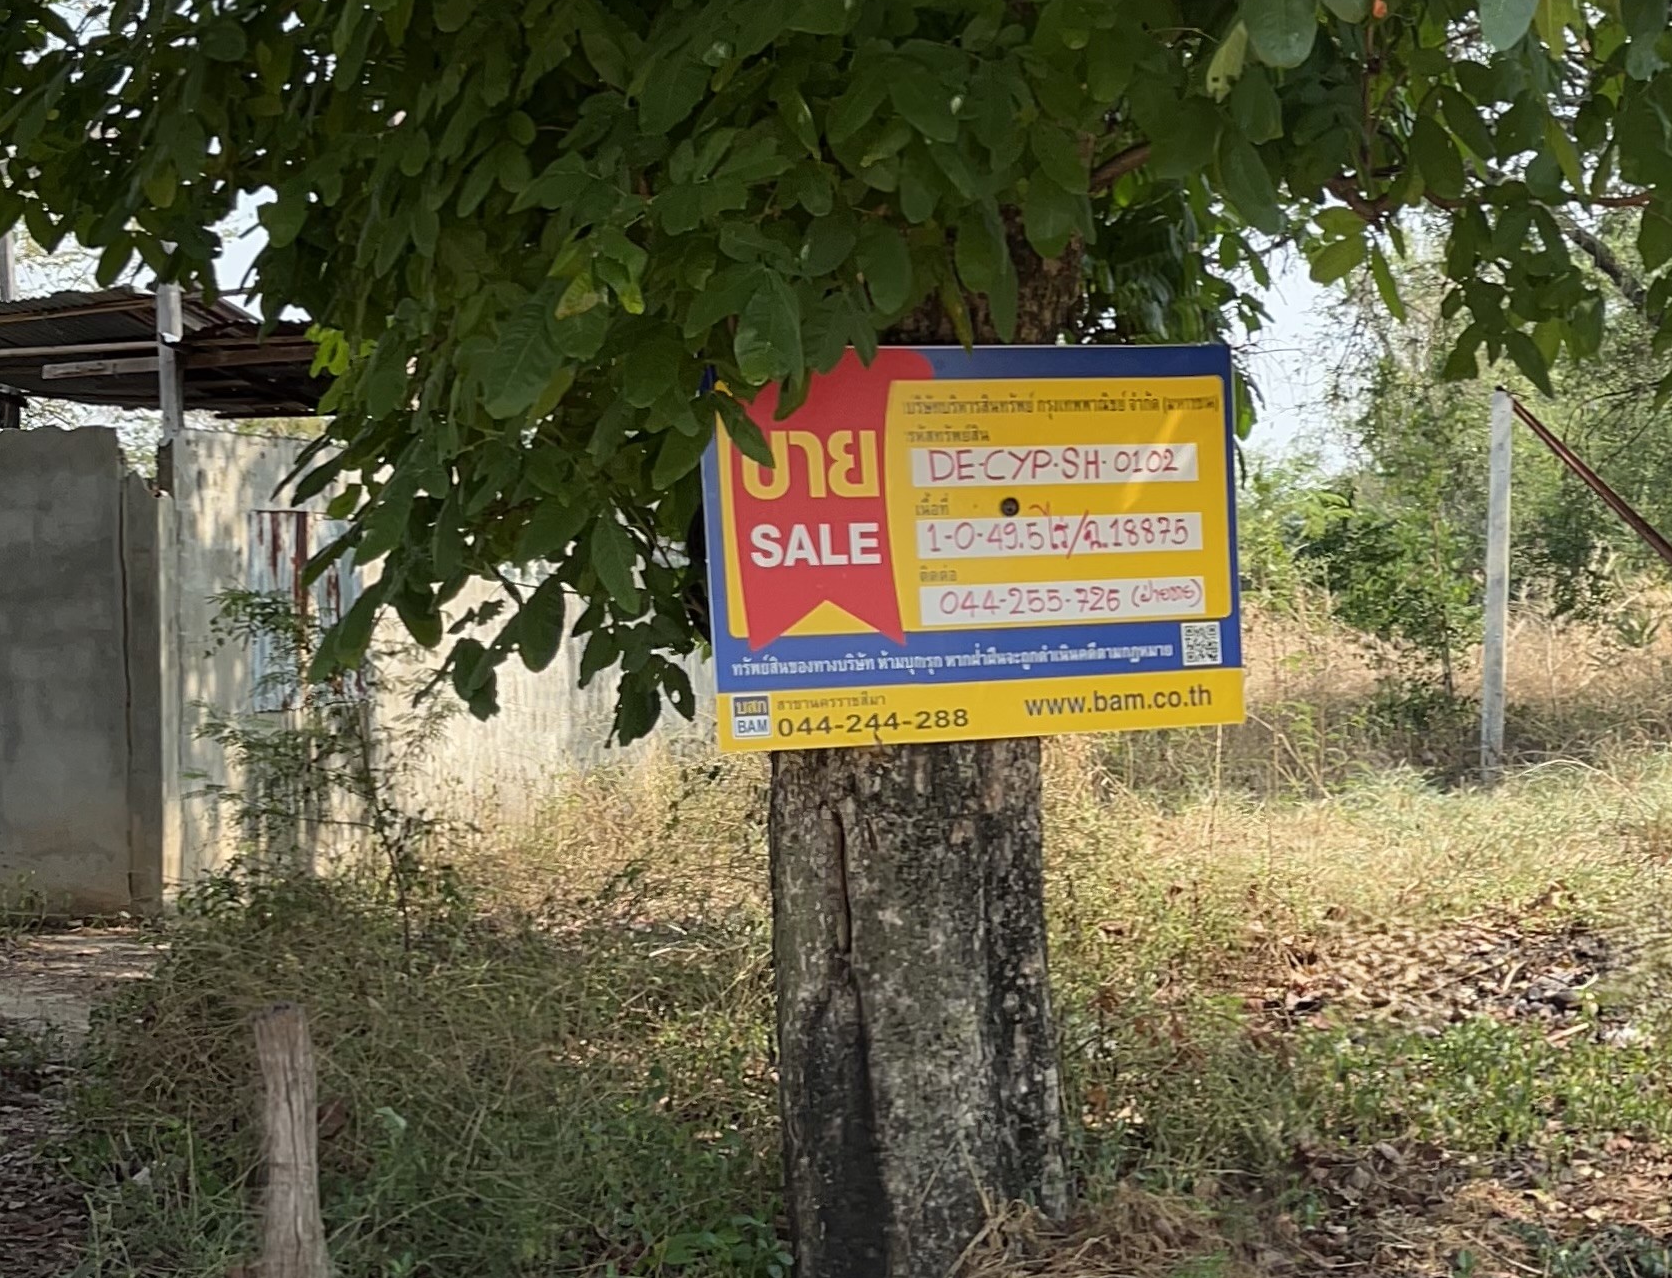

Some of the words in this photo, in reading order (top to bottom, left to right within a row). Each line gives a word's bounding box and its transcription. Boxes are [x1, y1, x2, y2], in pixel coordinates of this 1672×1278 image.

[742, 430, 880, 500] ขาย
[750, 522, 882, 568] SALE
[939, 586, 1121, 618] 044-255-726
[736, 700, 767, 715] บสก
[777, 691, 886, 711] สาขานครราชสีมา
[1025, 684, 1212, 716] www.bam.co.th
[737, 719, 768, 734] BAM
[778, 709, 969, 737] 044-244-288
